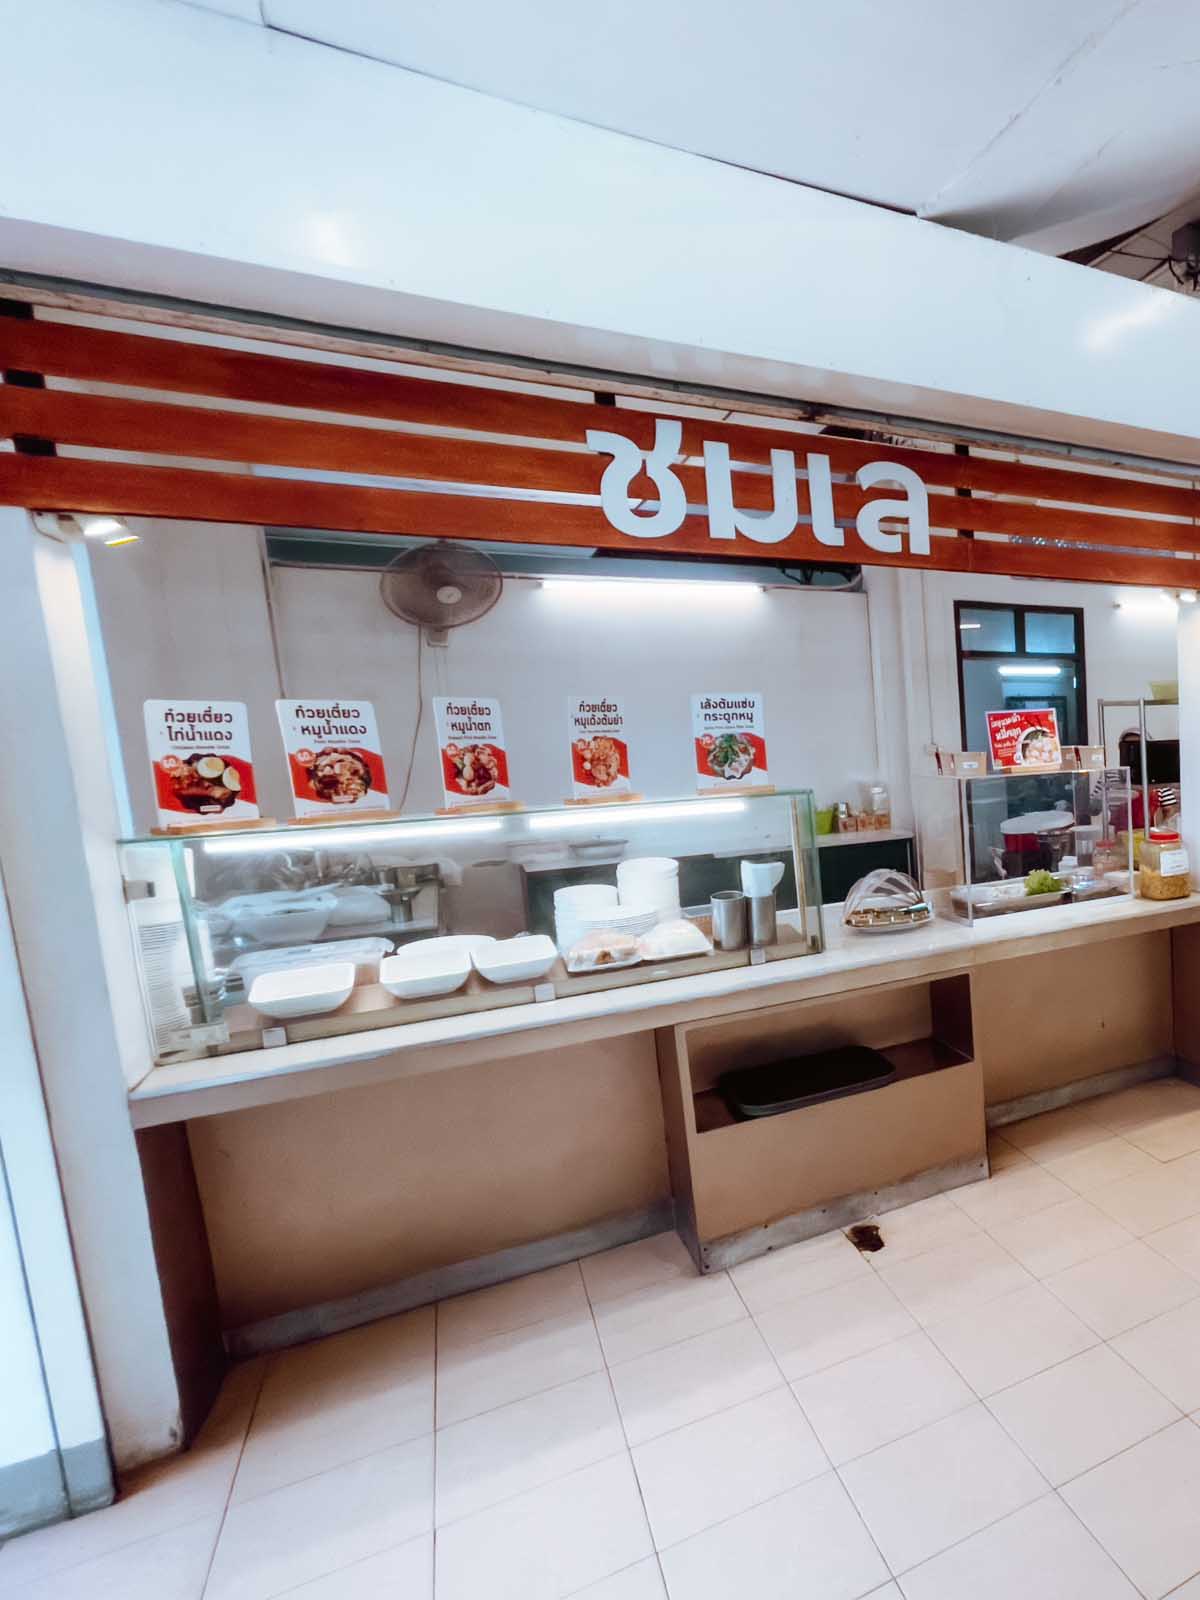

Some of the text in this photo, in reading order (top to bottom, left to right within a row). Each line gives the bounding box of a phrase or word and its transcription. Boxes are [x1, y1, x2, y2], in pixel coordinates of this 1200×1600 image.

[585, 418, 931, 556] ชมเล
[450, 716, 492, 735] หมูน้ำตก
[703, 712, 754, 724] กระดูกหมู
[166, 724, 234, 742] ไก่น้ำแดง
[300, 718, 368, 739] หมูน้ำแดง
